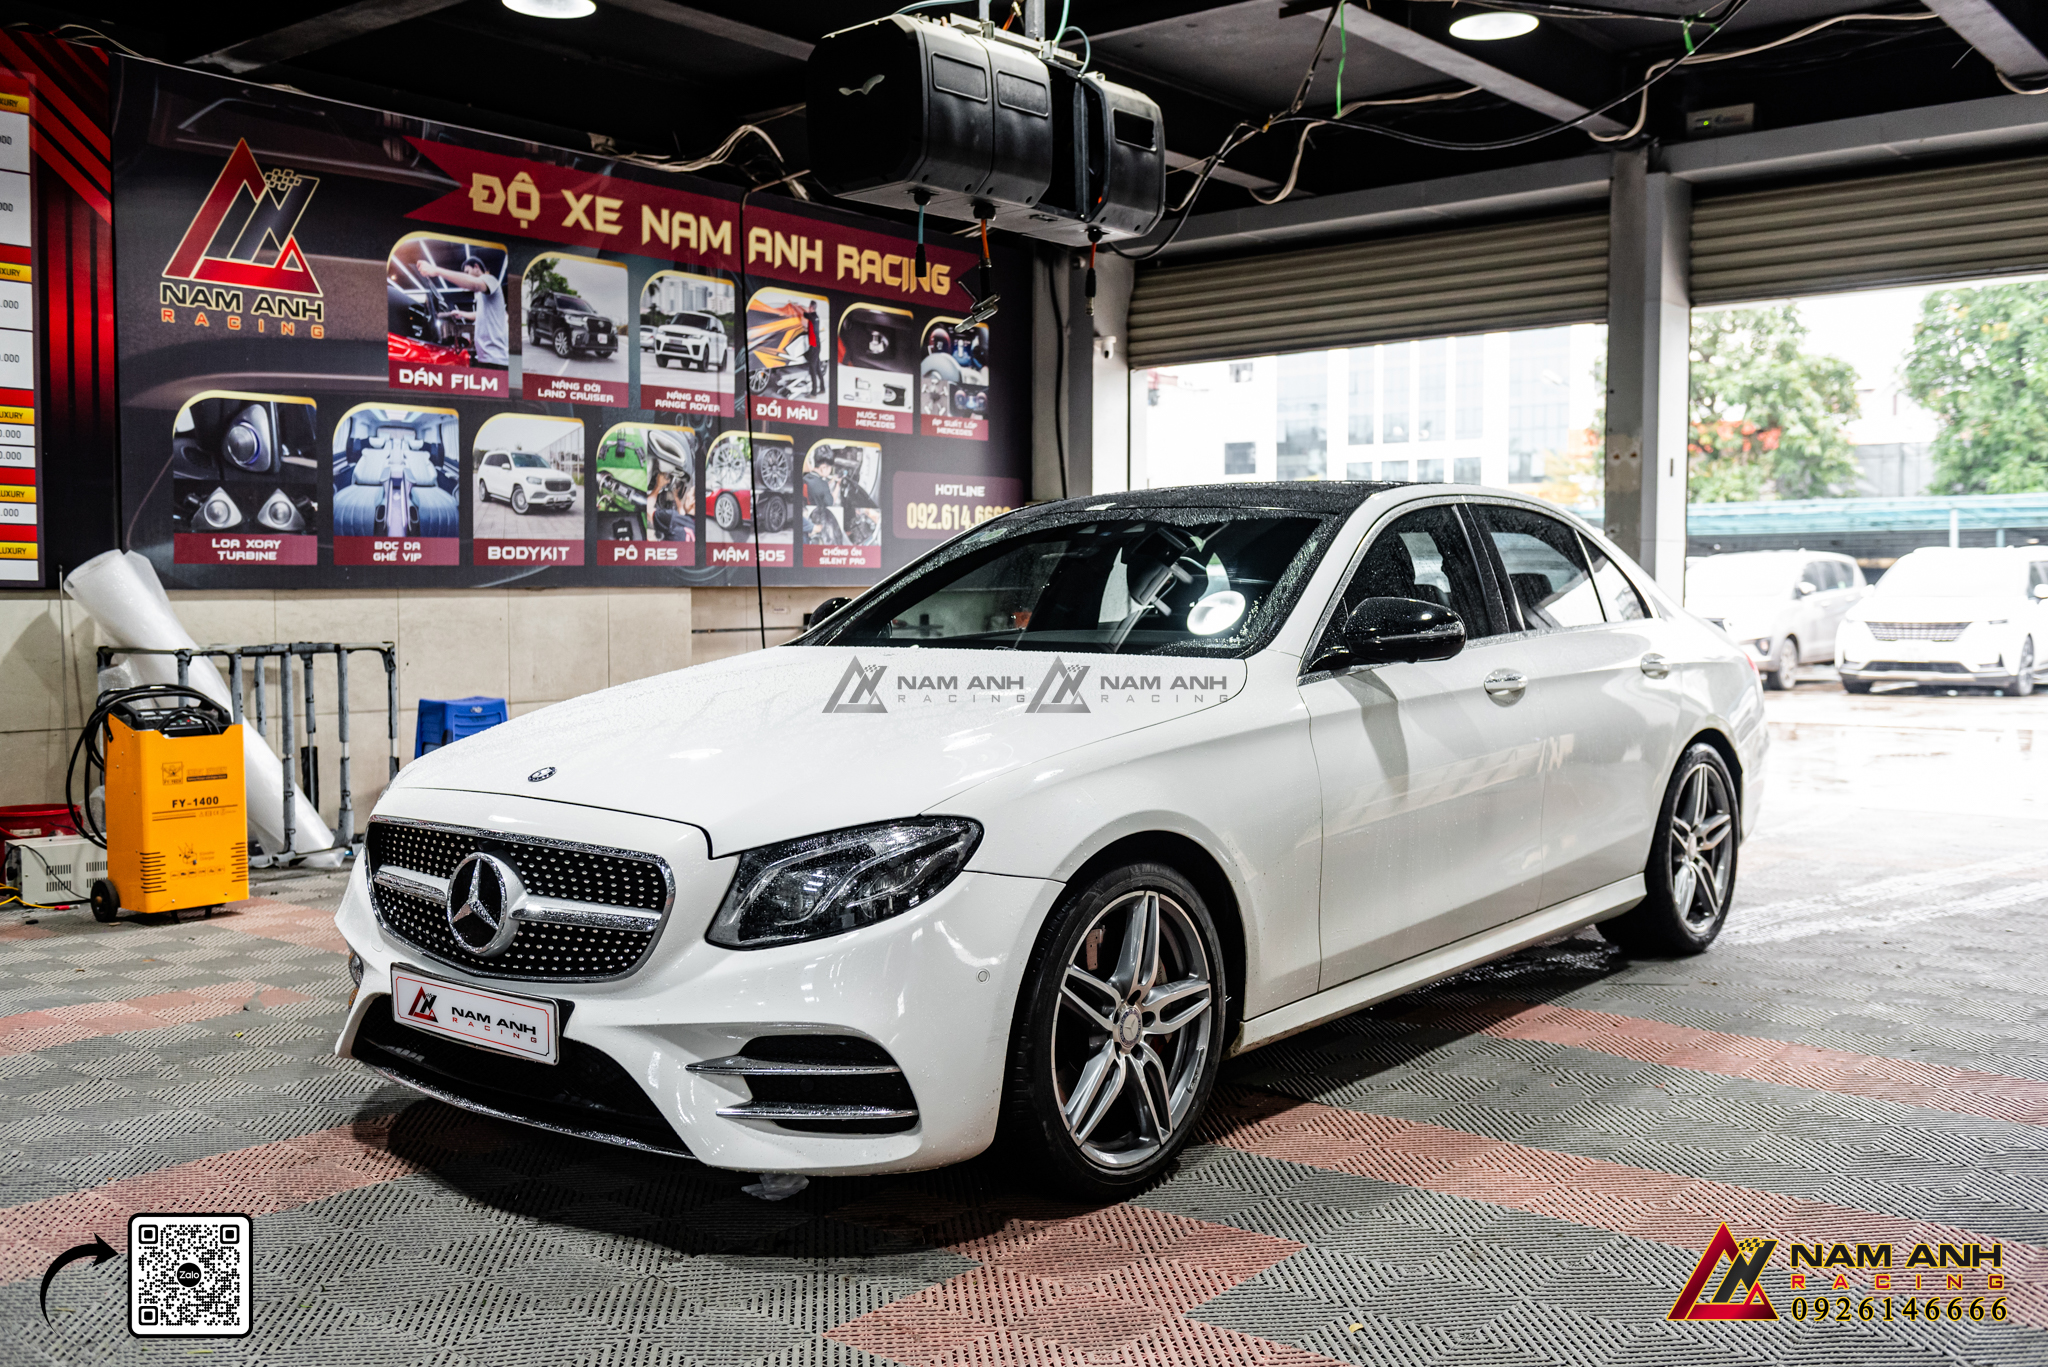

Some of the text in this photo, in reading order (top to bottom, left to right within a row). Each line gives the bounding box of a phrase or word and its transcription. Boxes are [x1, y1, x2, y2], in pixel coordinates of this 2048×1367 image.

[468, 171, 952, 296] ĐỘ XE NAM ANH RACING
[160, 282, 324, 323] NAM ANH
[161, 308, 324, 339] RACING
[398, 367, 498, 392] DÁN FILM
[551, 379, 580, 391] NÂNG
[537, 388, 614, 403] LAND CRUISER
[666, 390, 692, 402] NÂNG
[655, 399, 721, 413] RANGE ROVER
[756, 400, 818, 421] ĐỔI MÀU
[855, 419, 896, 430] MERCEDES
[878, 413, 895, 422] HOA
[936, 426, 974, 437] MERCEDES
[935, 484, 986, 497] HOTLINE
[211, 538, 282, 550] LOA XOAY
[403, 541, 421, 551] DA
[217, 550, 278, 561] TURBINE
[402, 552, 422, 562] VIP
[487, 545, 570, 562] BODYKIT
[613, 544, 679, 562] PÔ RES
[712, 546, 750, 563] MÂM
[819, 557, 866, 566] SILENT PRO
[171, 795, 219, 809] FY-1400
[451, 1006, 537, 1036] NAM ANH
[452, 1016, 537, 1044] RACING
